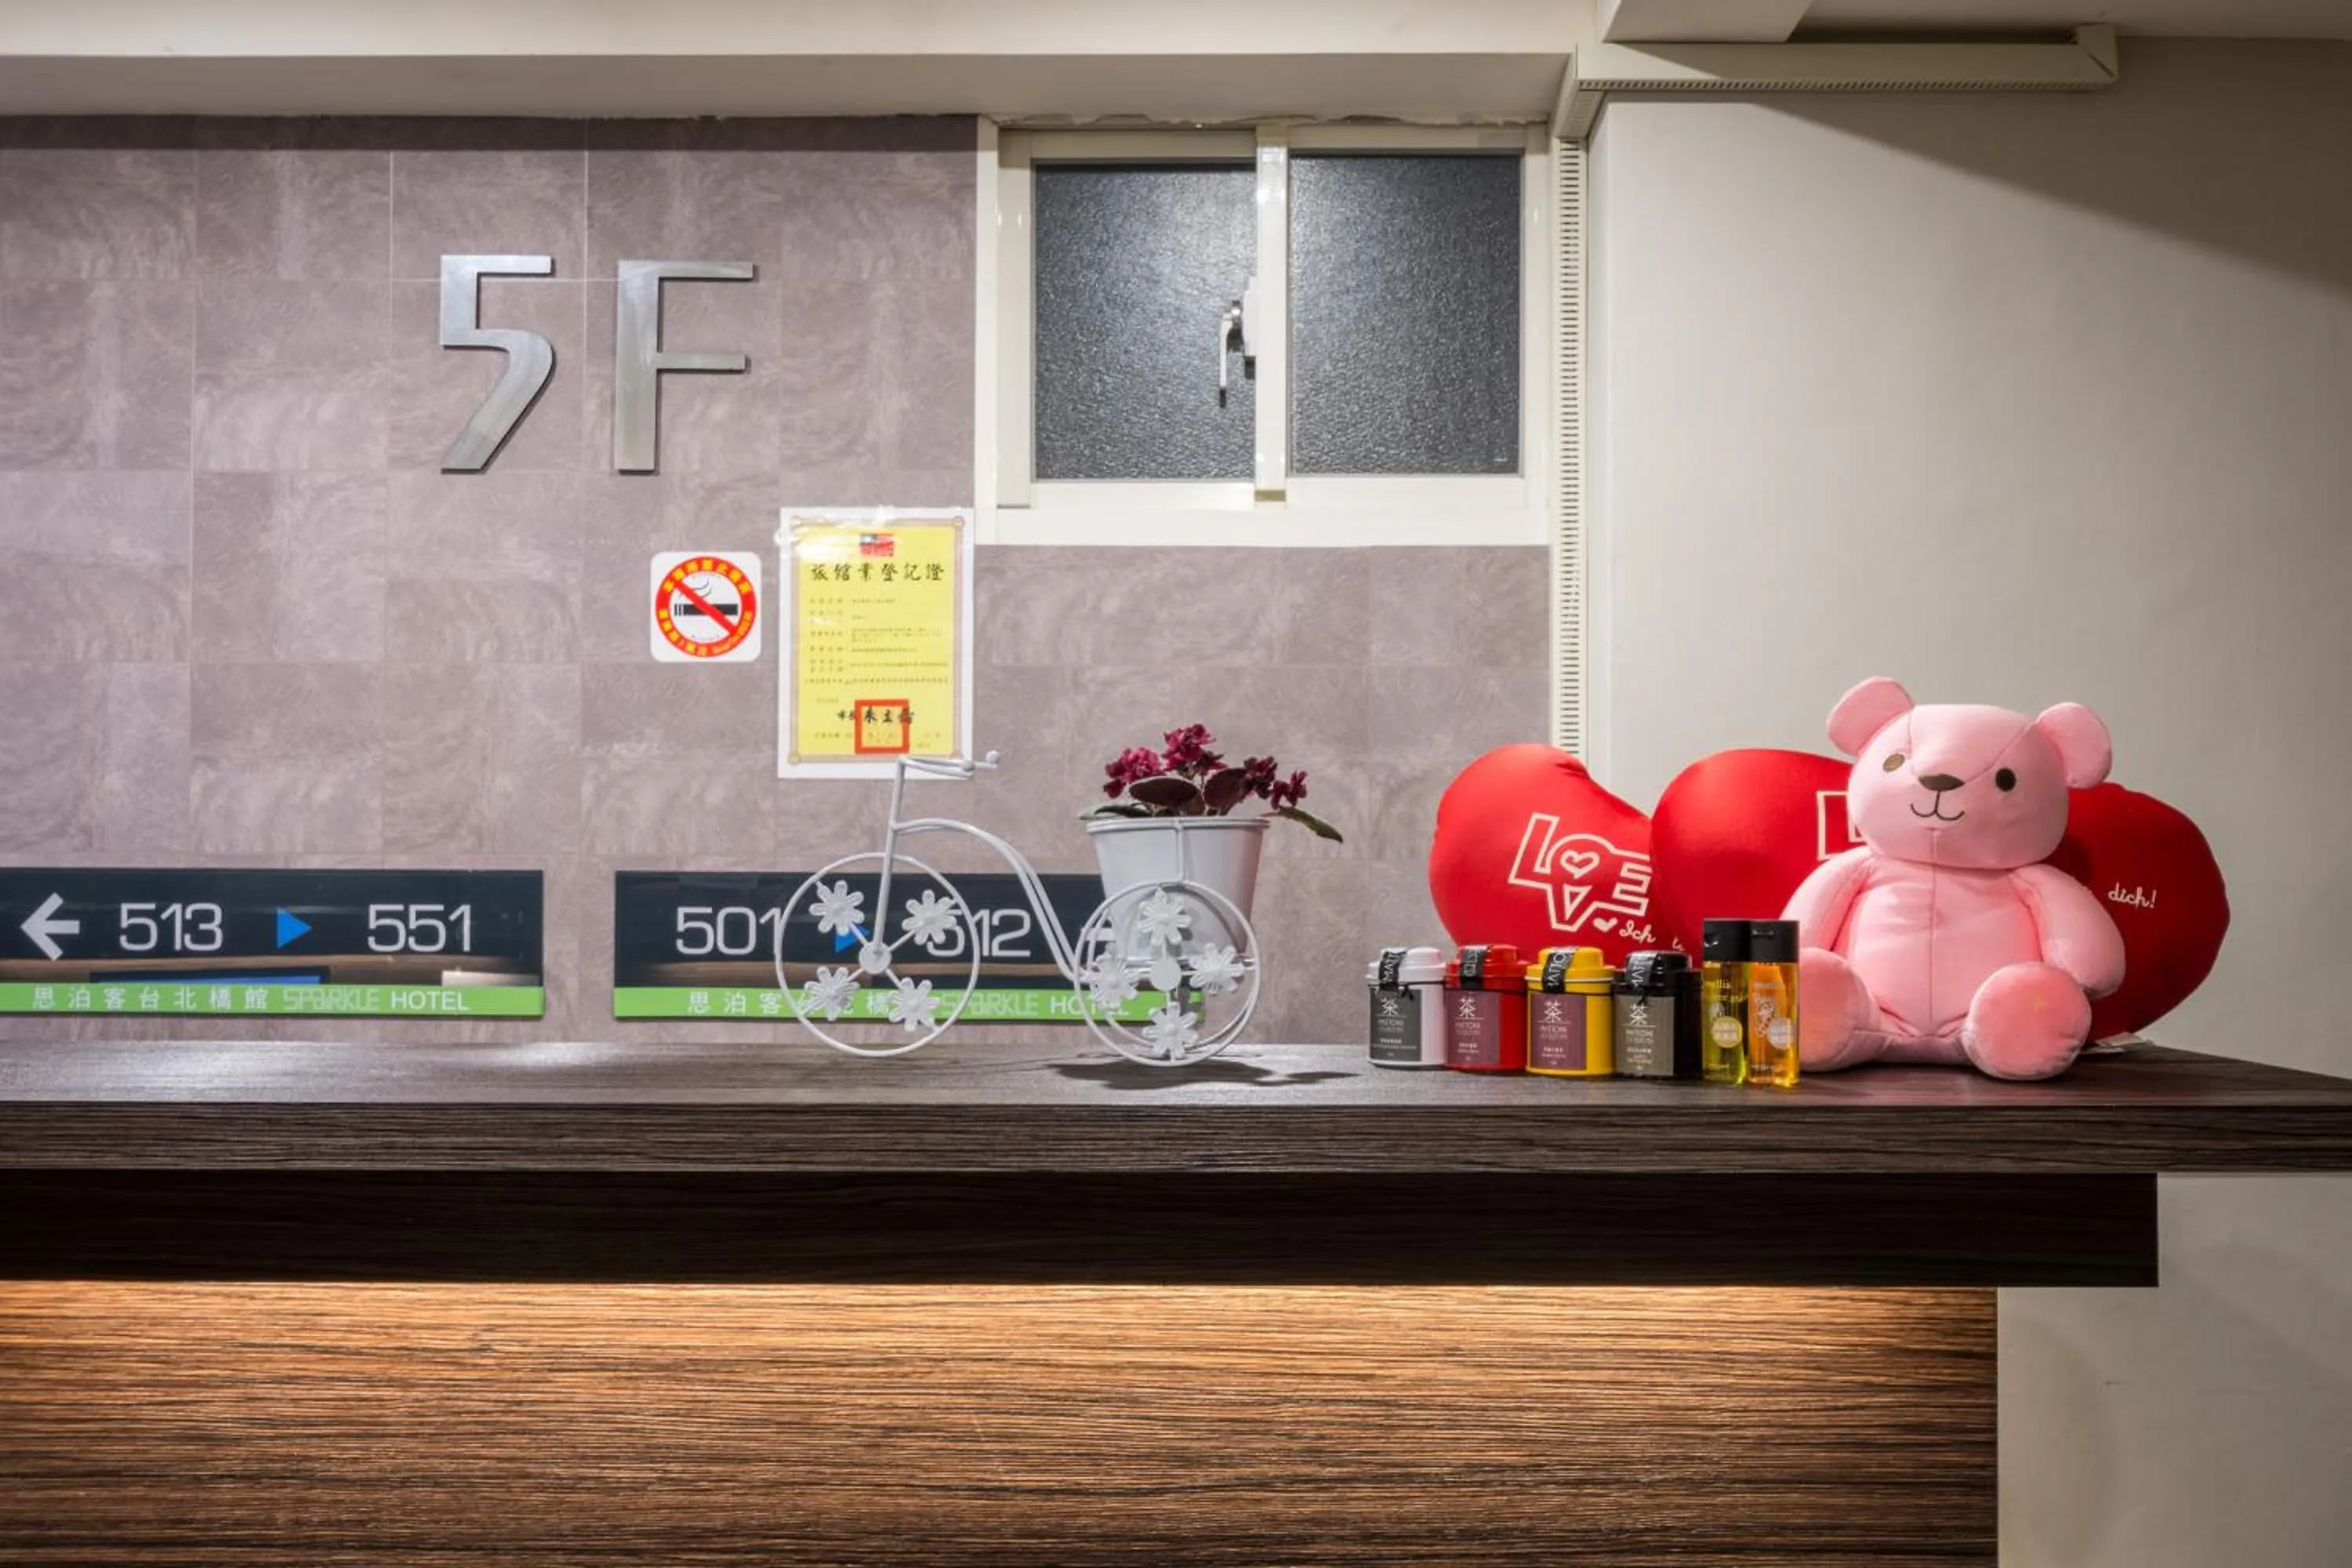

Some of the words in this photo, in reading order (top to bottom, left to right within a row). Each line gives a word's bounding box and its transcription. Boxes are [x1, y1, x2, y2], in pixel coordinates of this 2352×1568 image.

[439, 255, 754, 472] 5F
[2108, 882, 2156, 909] dich!
[120, 902, 223, 951] 513
[368, 903, 471, 953] 551
[677, 907, 782, 955] 501
[391, 990, 470, 1011] HOTEL
[688, 990, 925, 1015] 思泊客橋
[1051, 994, 1130, 1015] HOT
